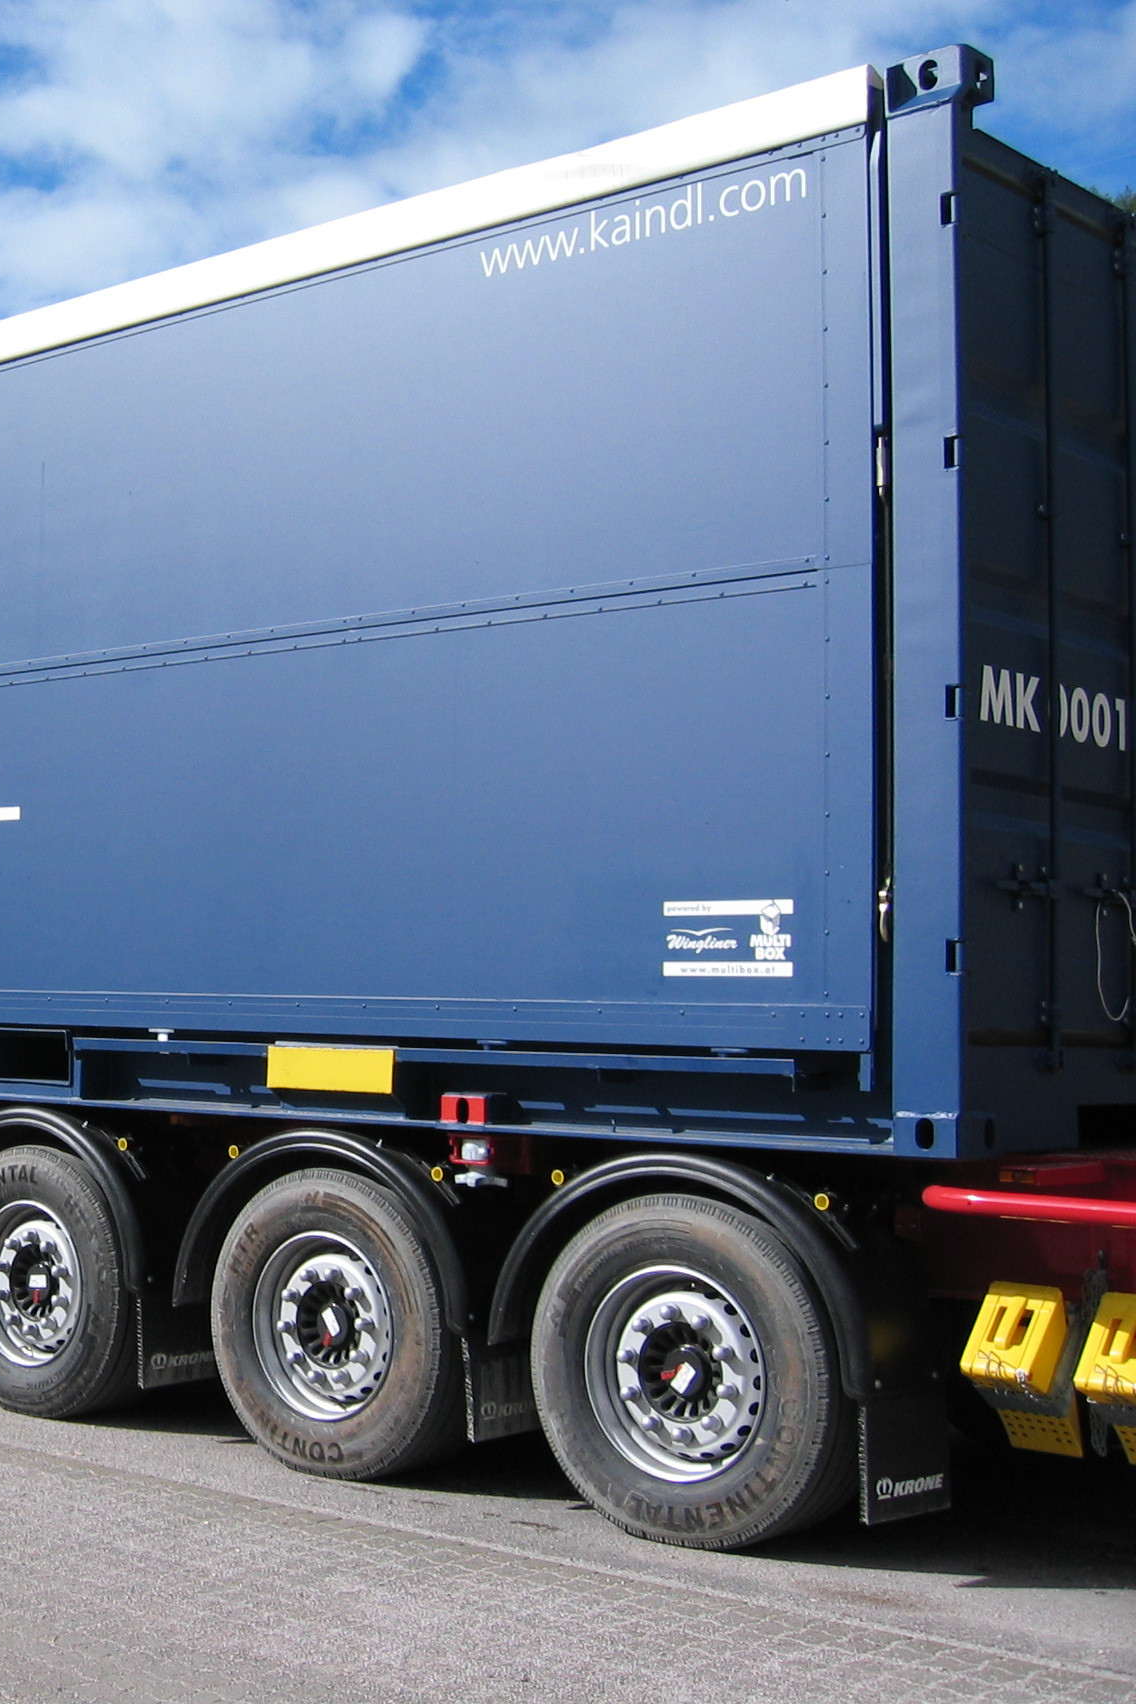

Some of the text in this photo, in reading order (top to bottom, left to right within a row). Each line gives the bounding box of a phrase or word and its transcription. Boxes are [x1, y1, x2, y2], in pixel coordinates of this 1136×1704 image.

[480, 168, 807, 277] www.kaindl.com
[980, 664, 1041, 733] MK
[666, 934, 738, 953] Wingliner
[750, 934, 791, 948] MULTI
[755, 947, 786, 960] BOX
[167, 1350, 214, 1368] KRON
[893, 1473, 944, 1497] KRONE
